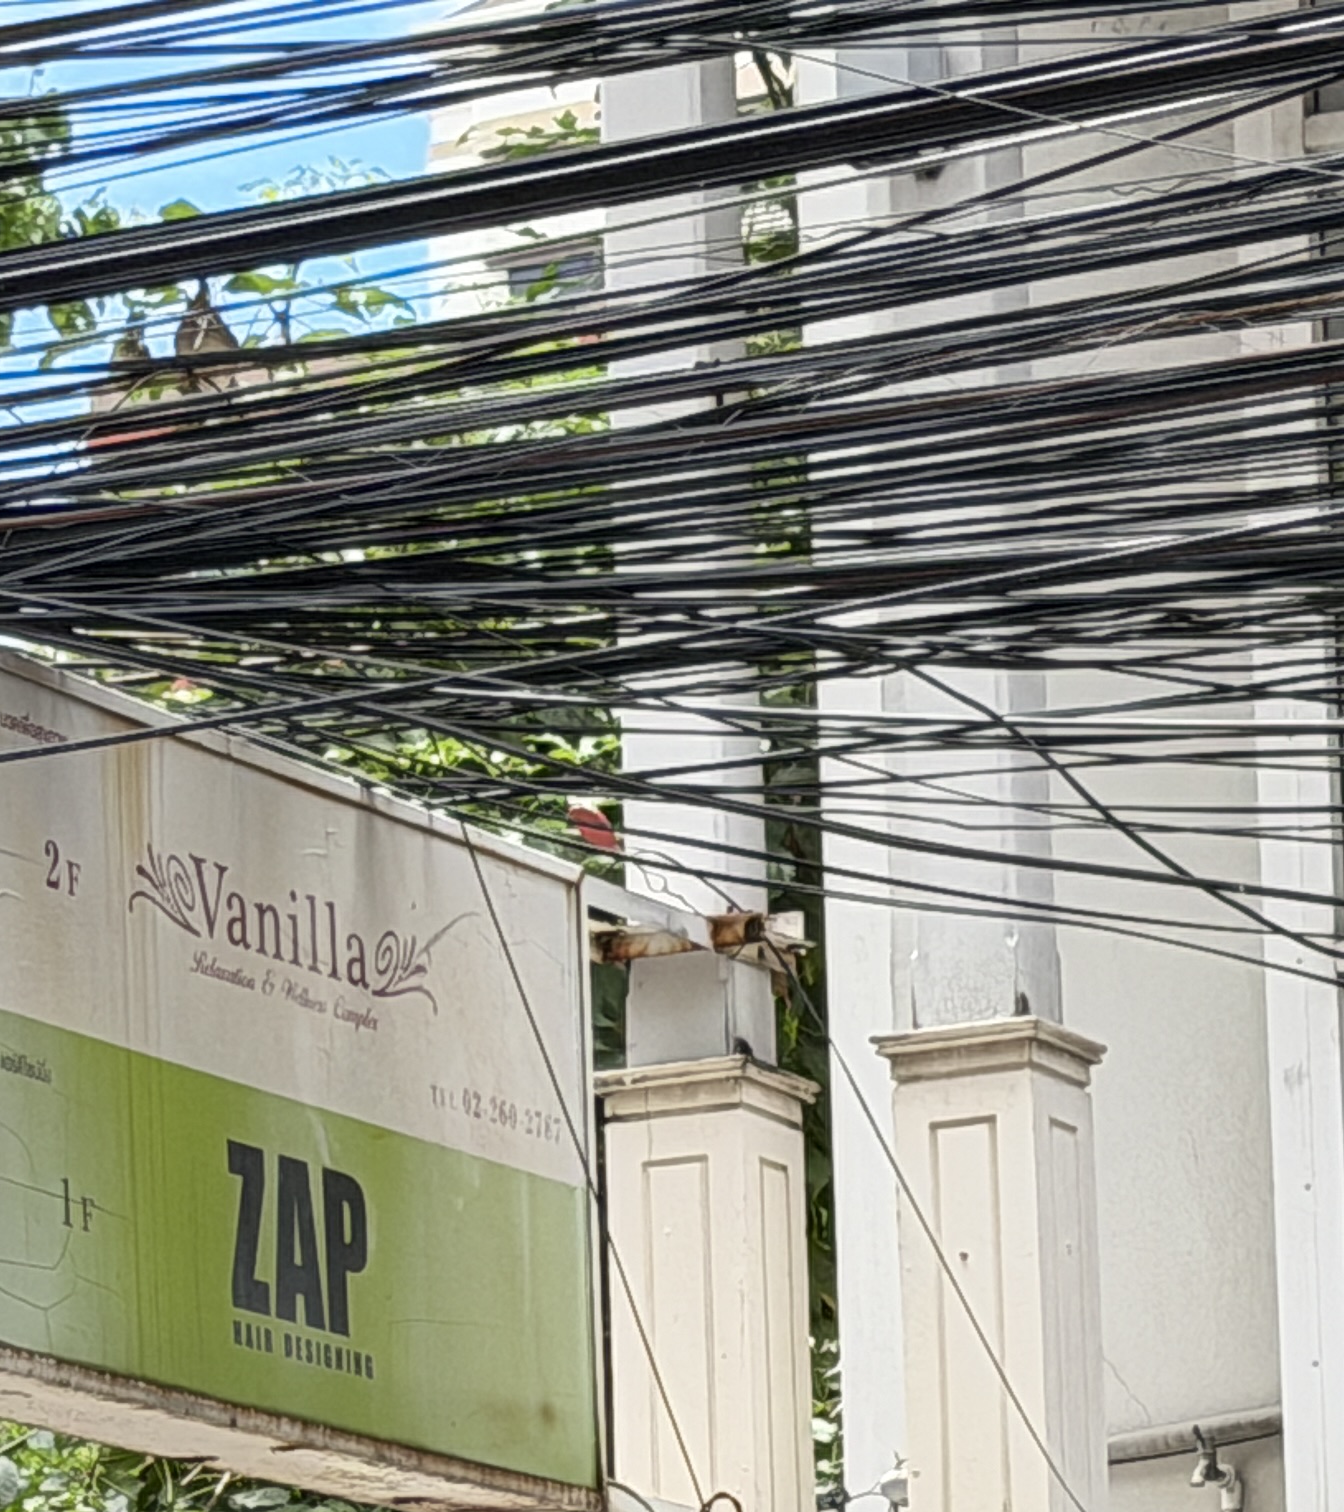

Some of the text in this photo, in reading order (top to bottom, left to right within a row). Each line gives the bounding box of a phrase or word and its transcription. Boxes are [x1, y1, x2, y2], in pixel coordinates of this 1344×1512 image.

[188, 852, 370, 990] Vanilla
[261, 968, 276, 996] &
[333, 994, 379, 1032] Complex
[226, 1138, 368, 1338] ZAP
[233, 1319, 374, 1380] HAIR DESIGNING
